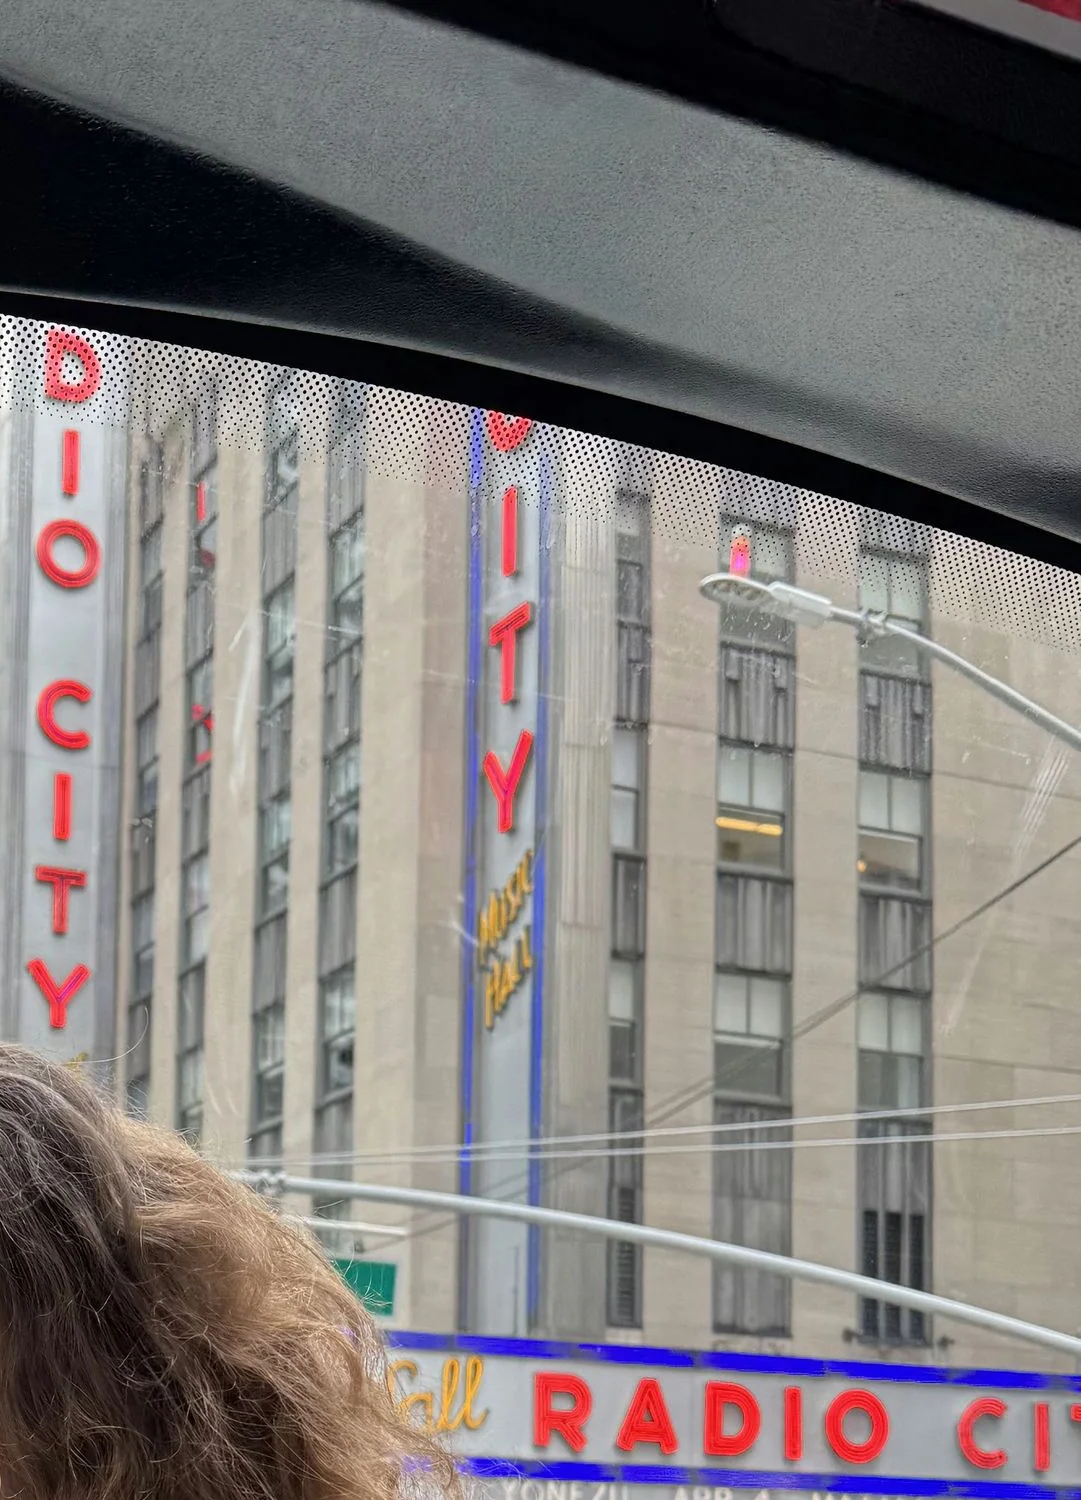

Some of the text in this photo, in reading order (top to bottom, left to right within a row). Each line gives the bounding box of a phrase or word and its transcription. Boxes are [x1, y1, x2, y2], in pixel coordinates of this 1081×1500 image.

[28, 679, 91, 1029] CITY
[534, 1372, 889, 1464] RADIO
[957, 1396, 1081, 1473] CI
